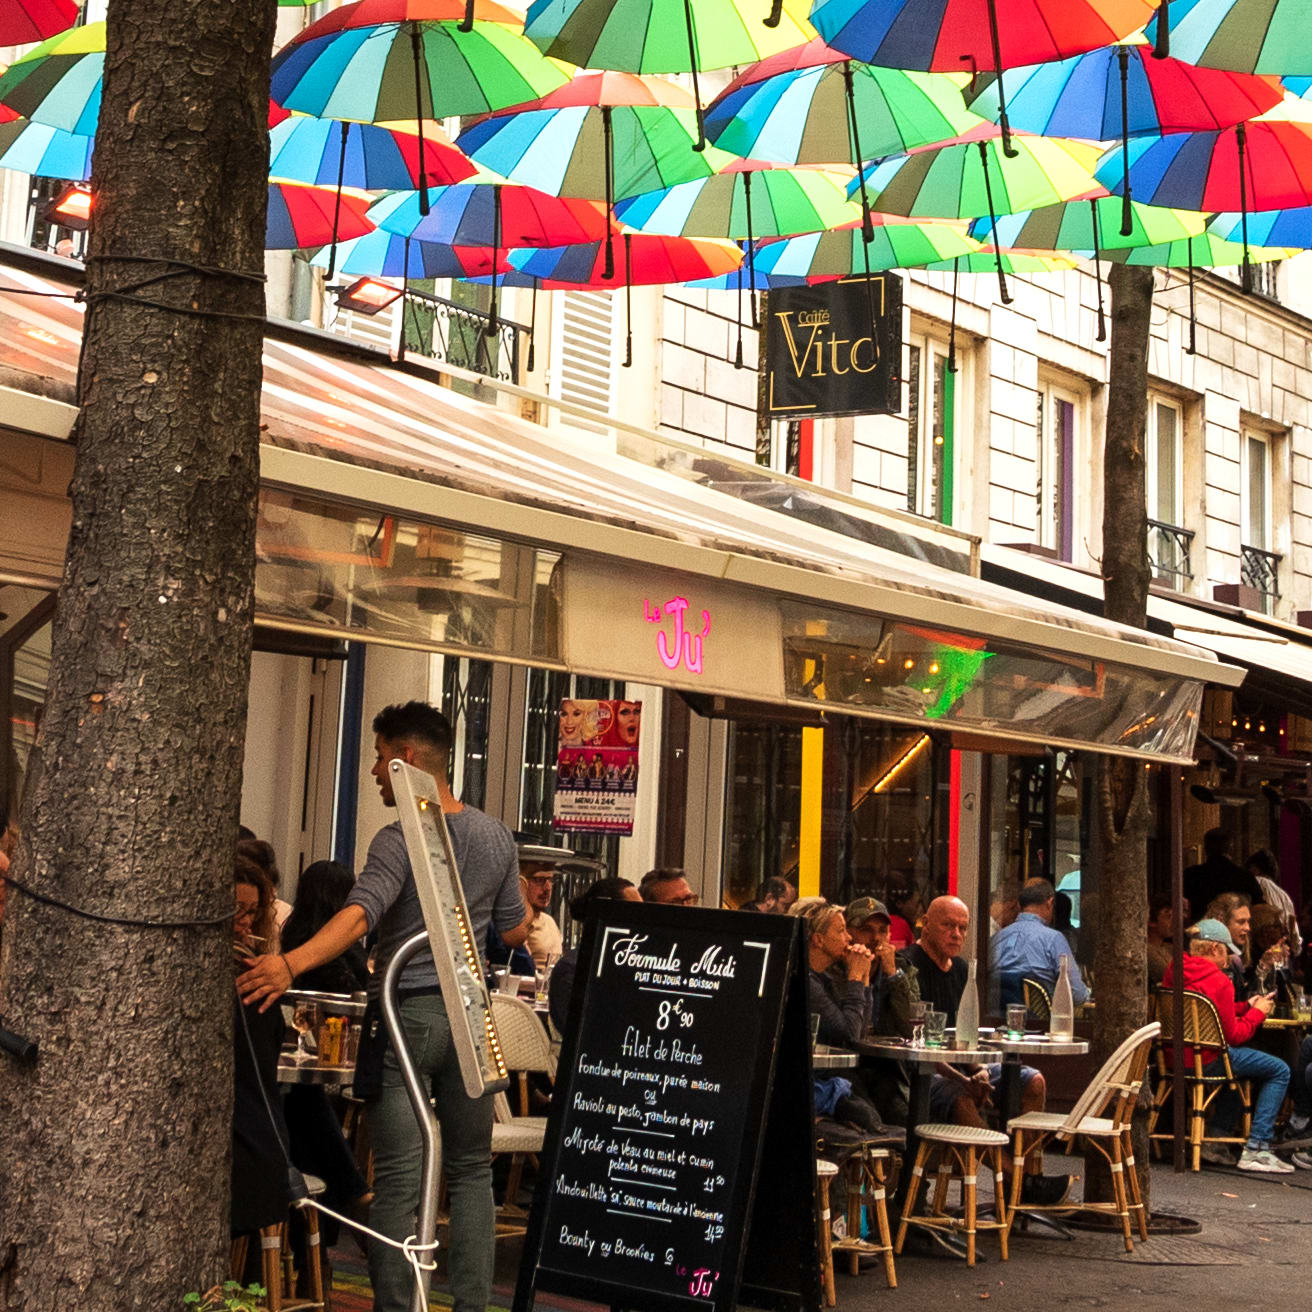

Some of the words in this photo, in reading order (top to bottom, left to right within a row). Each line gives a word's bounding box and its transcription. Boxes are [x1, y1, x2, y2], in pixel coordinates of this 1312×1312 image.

[612, 934, 681, 971] Formule
[690, 944, 737, 978] Midi
[653, 1040, 668, 1061] de
[573, 1091, 605, 1113] Ravioli
[605, 1103, 617, 1115] au
[679, 1112, 691, 1128] de
[691, 1118, 715, 1136] pays
[606, 1139, 619, 1155] de
[642, 1146, 655, 1160] au
[656, 1148, 676, 1163] miel
[677, 1151, 686, 1166] et
[558, 1224, 596, 1258] Bounty
